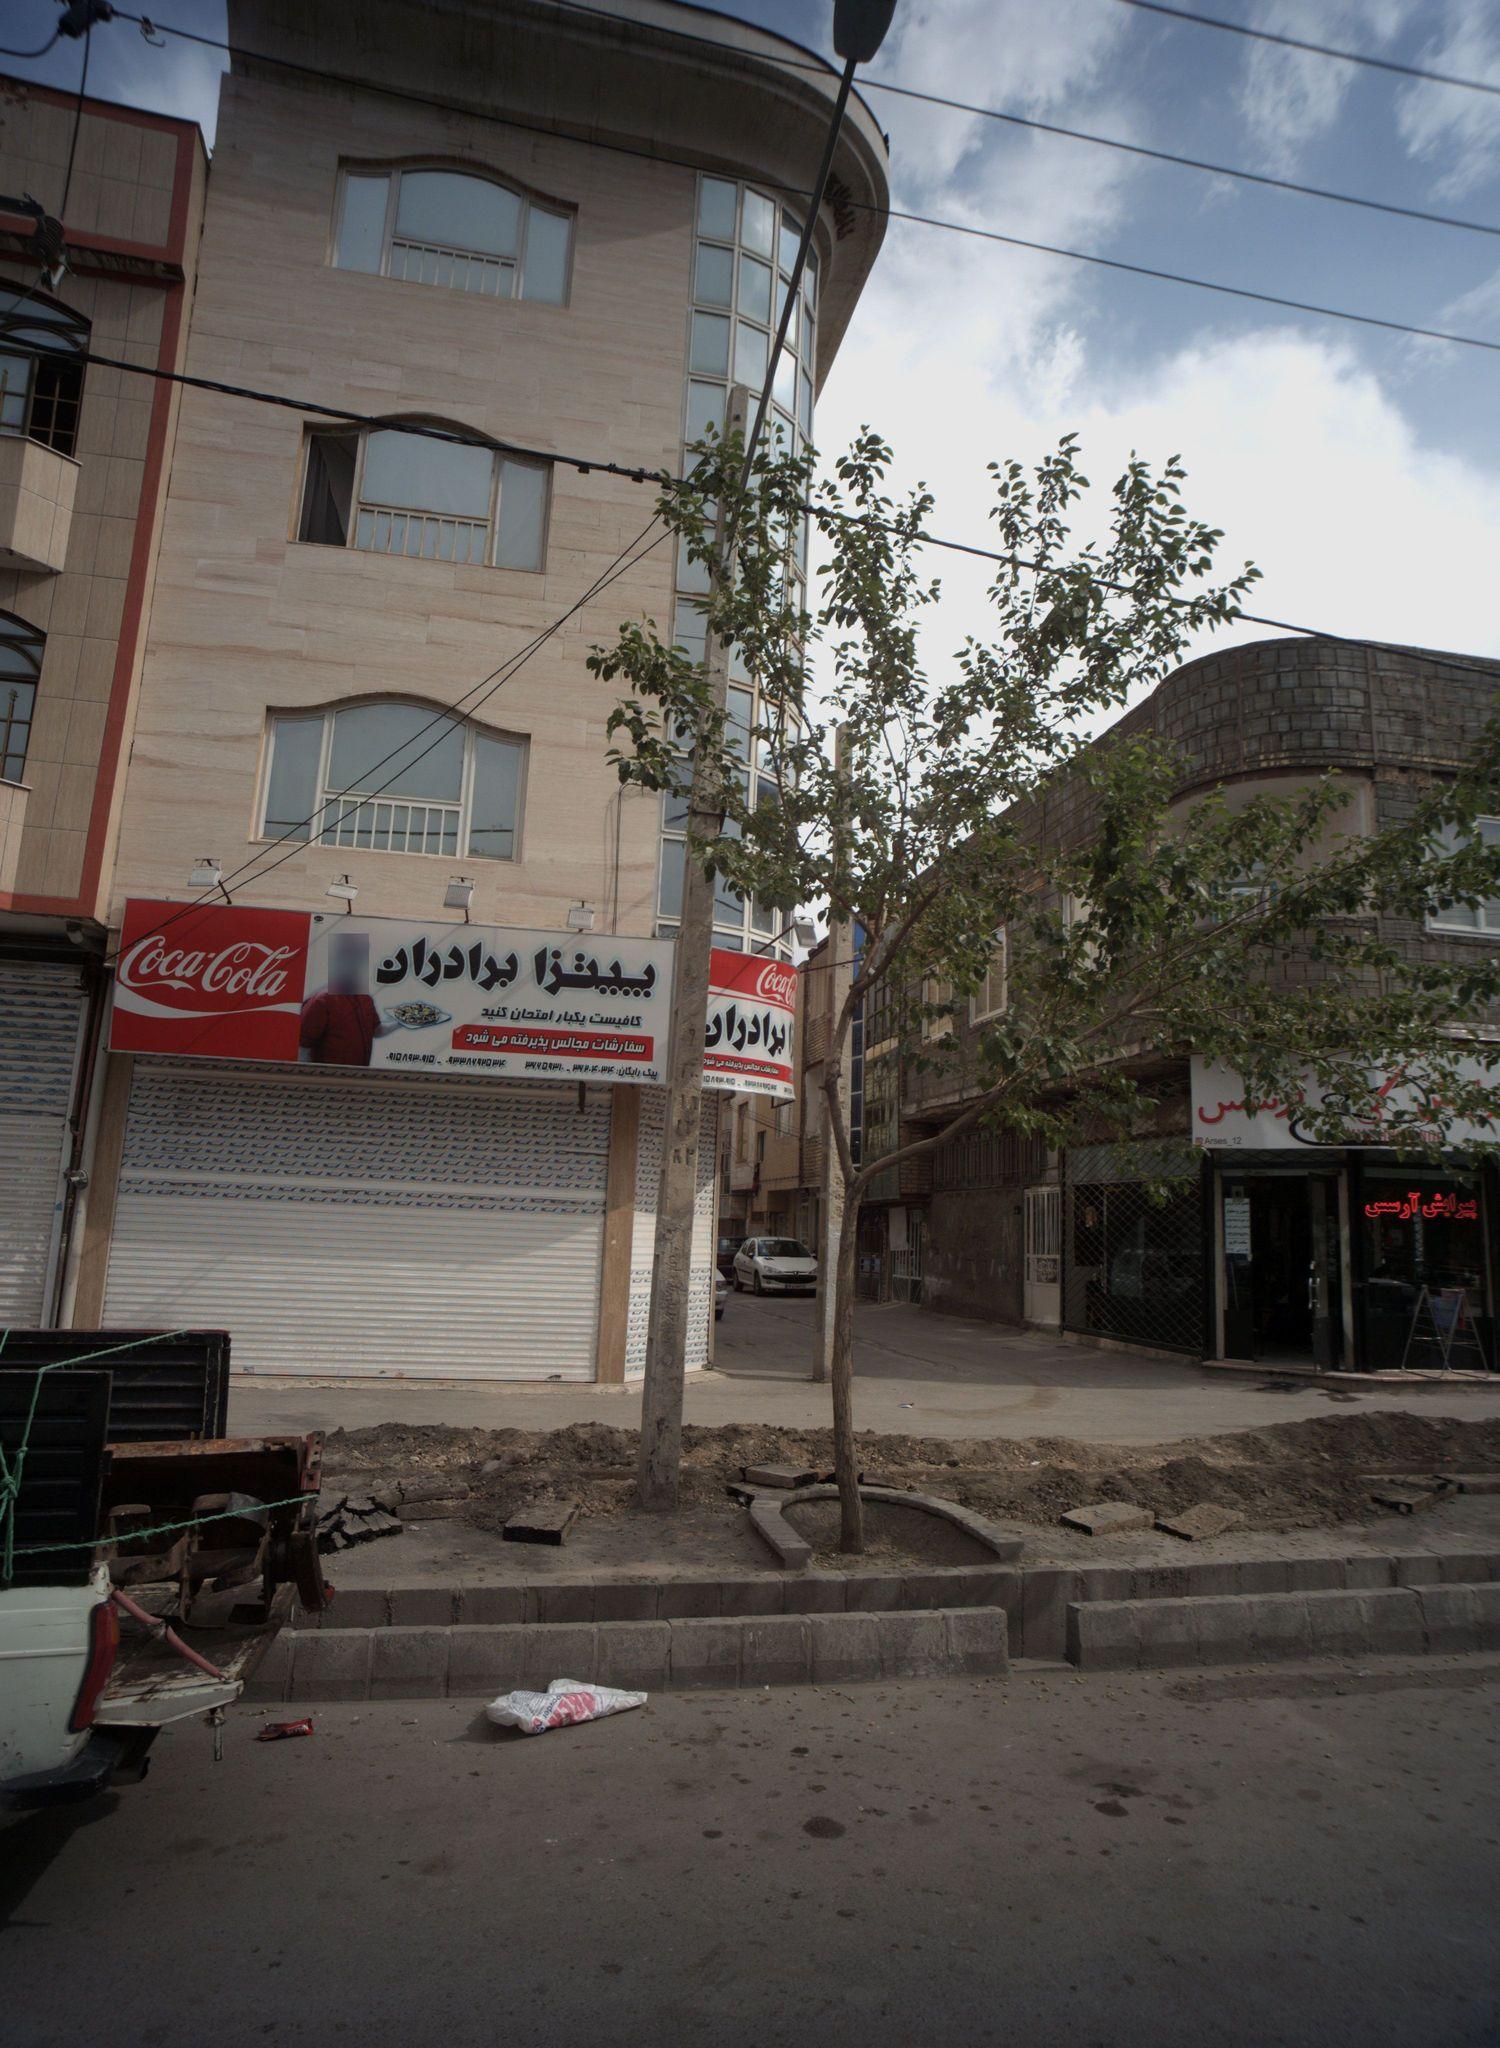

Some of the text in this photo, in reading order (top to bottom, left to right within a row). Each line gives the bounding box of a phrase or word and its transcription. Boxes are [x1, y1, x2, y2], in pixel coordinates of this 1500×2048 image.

[376, 937, 656, 998] پیتزا برادران
[481, 1006, 642, 1029] کافیست یکبار امتحان کنید
[465, 1029, 645, 1053] سفارشات مجالس پذیرفته می شود
[1204, 1136, 1242, 1147] Arses_12
